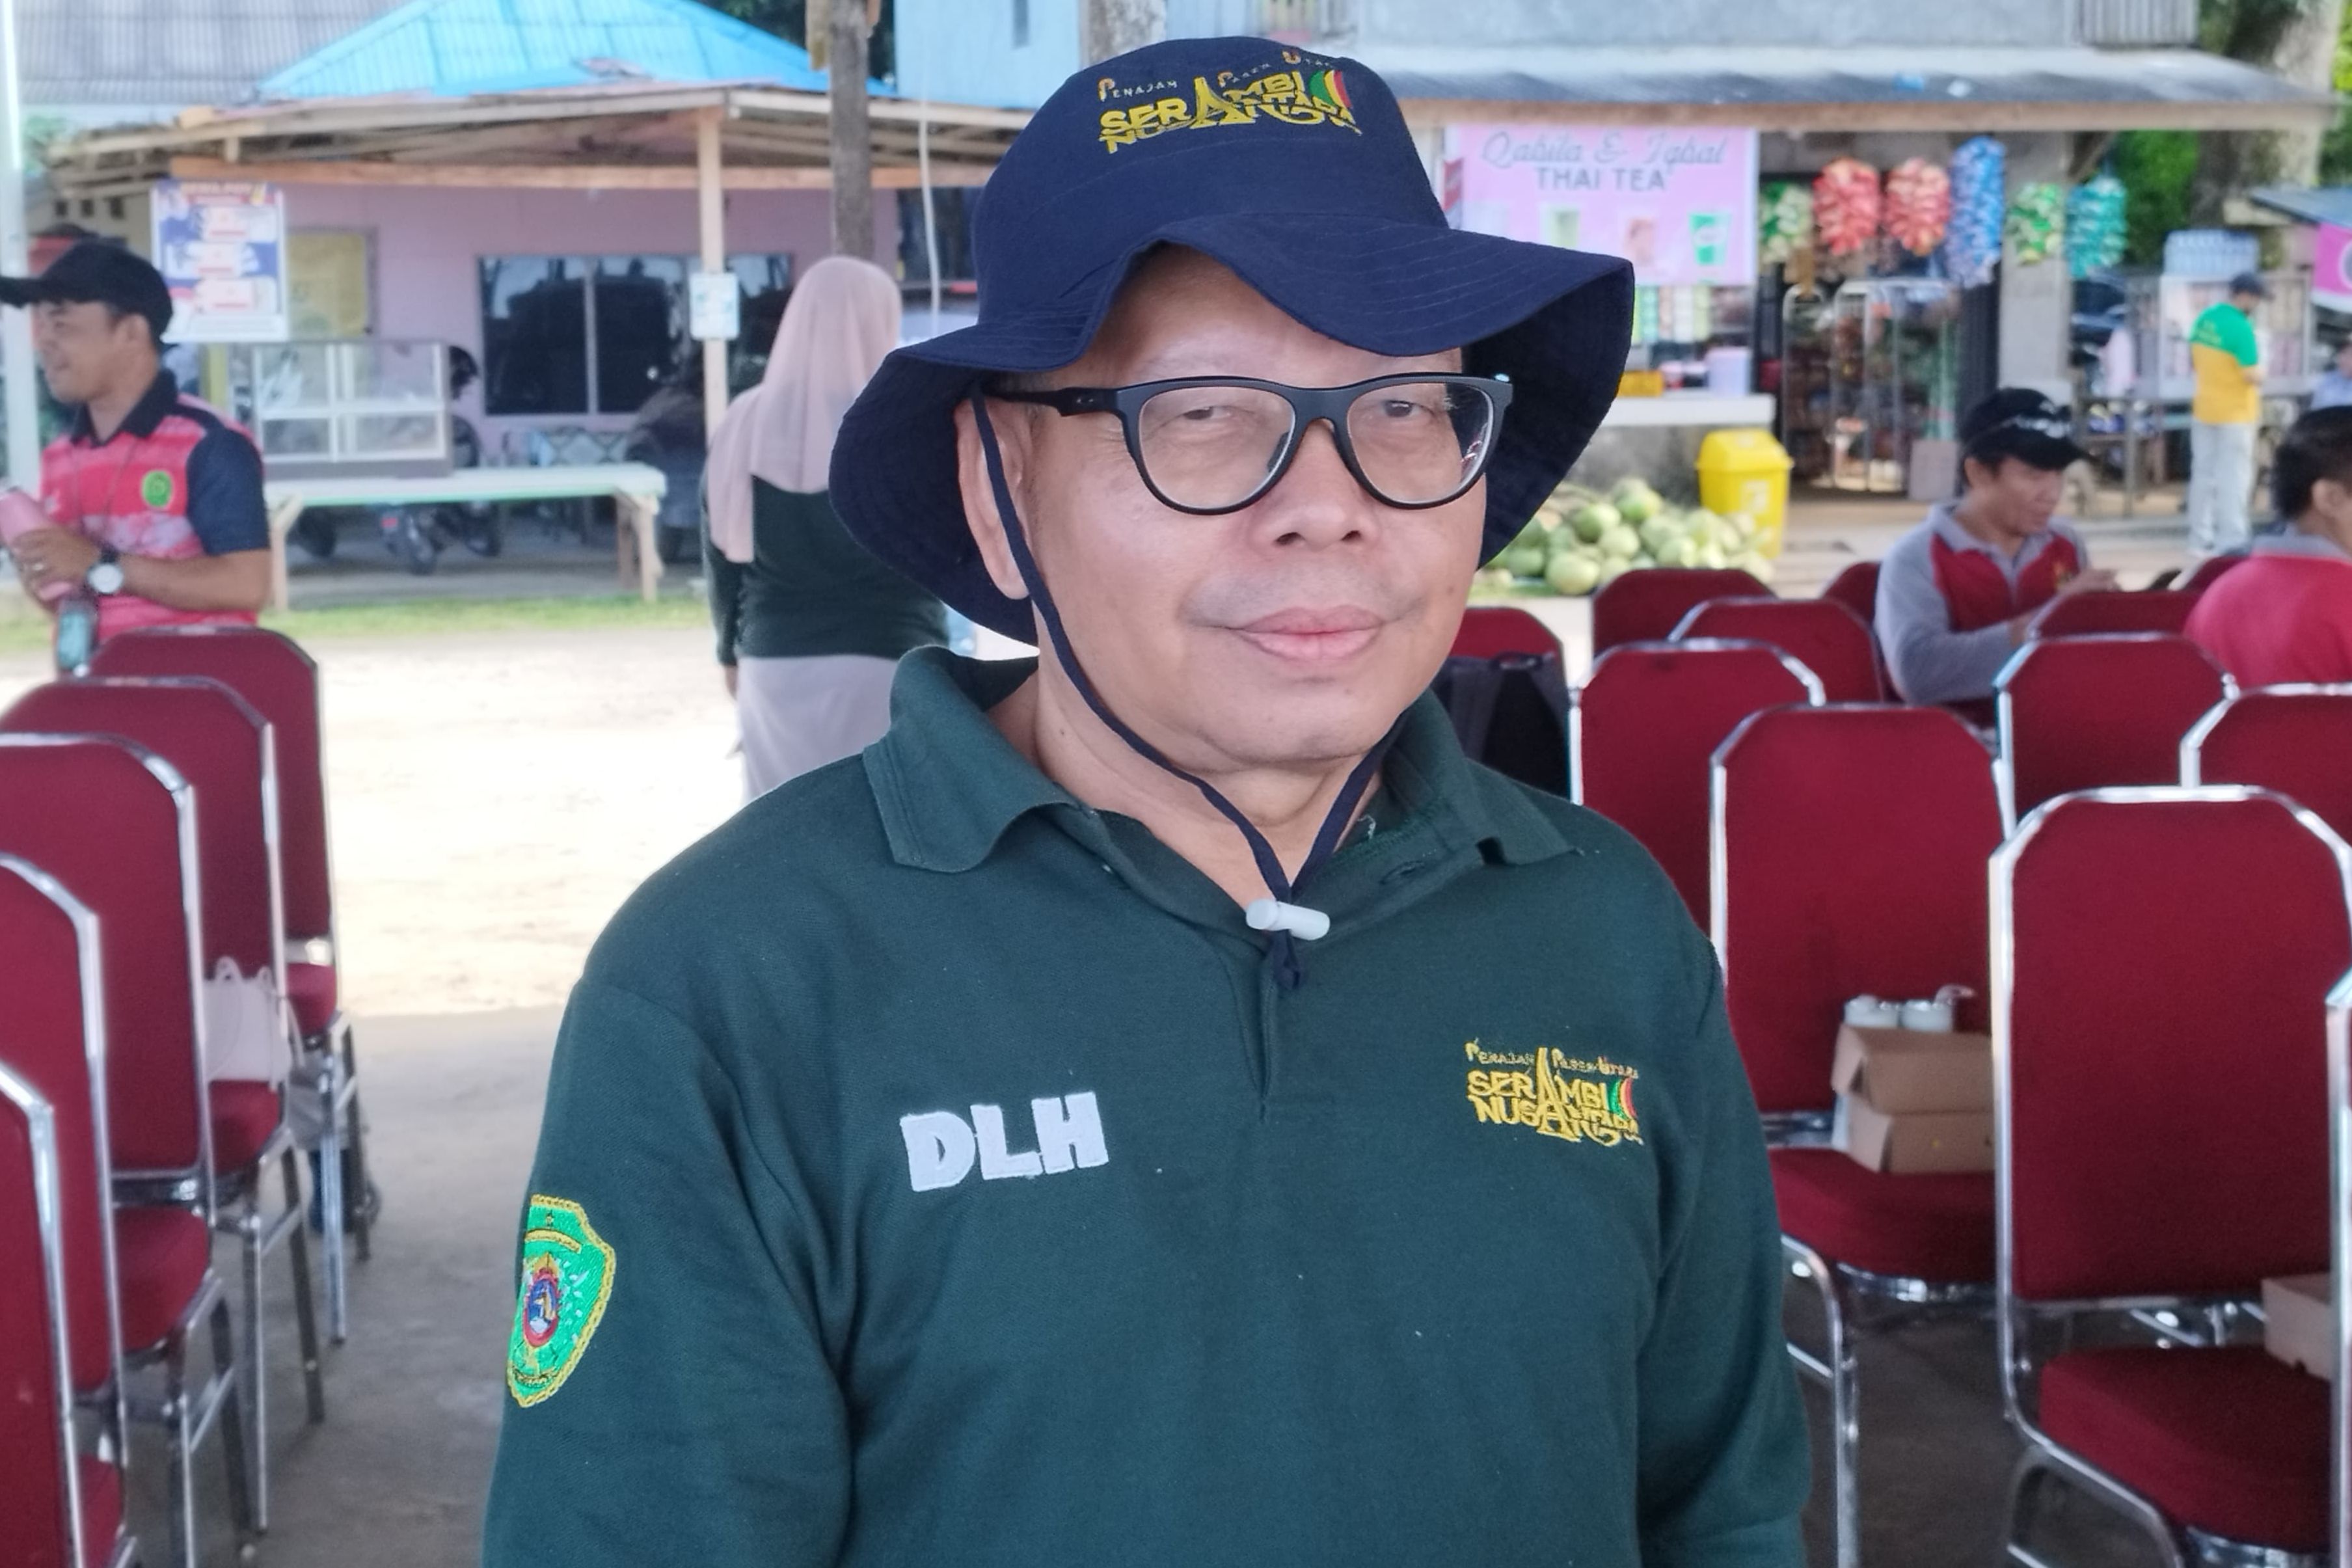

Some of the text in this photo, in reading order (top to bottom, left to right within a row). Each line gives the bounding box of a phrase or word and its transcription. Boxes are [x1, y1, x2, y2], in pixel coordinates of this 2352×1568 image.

[1594, 129, 1627, 164] &
[1535, 167, 1666, 191] THAI TEA
[1467, 1048, 1610, 1119] SERAMBI
[900, 1091, 1109, 1192] DLH
